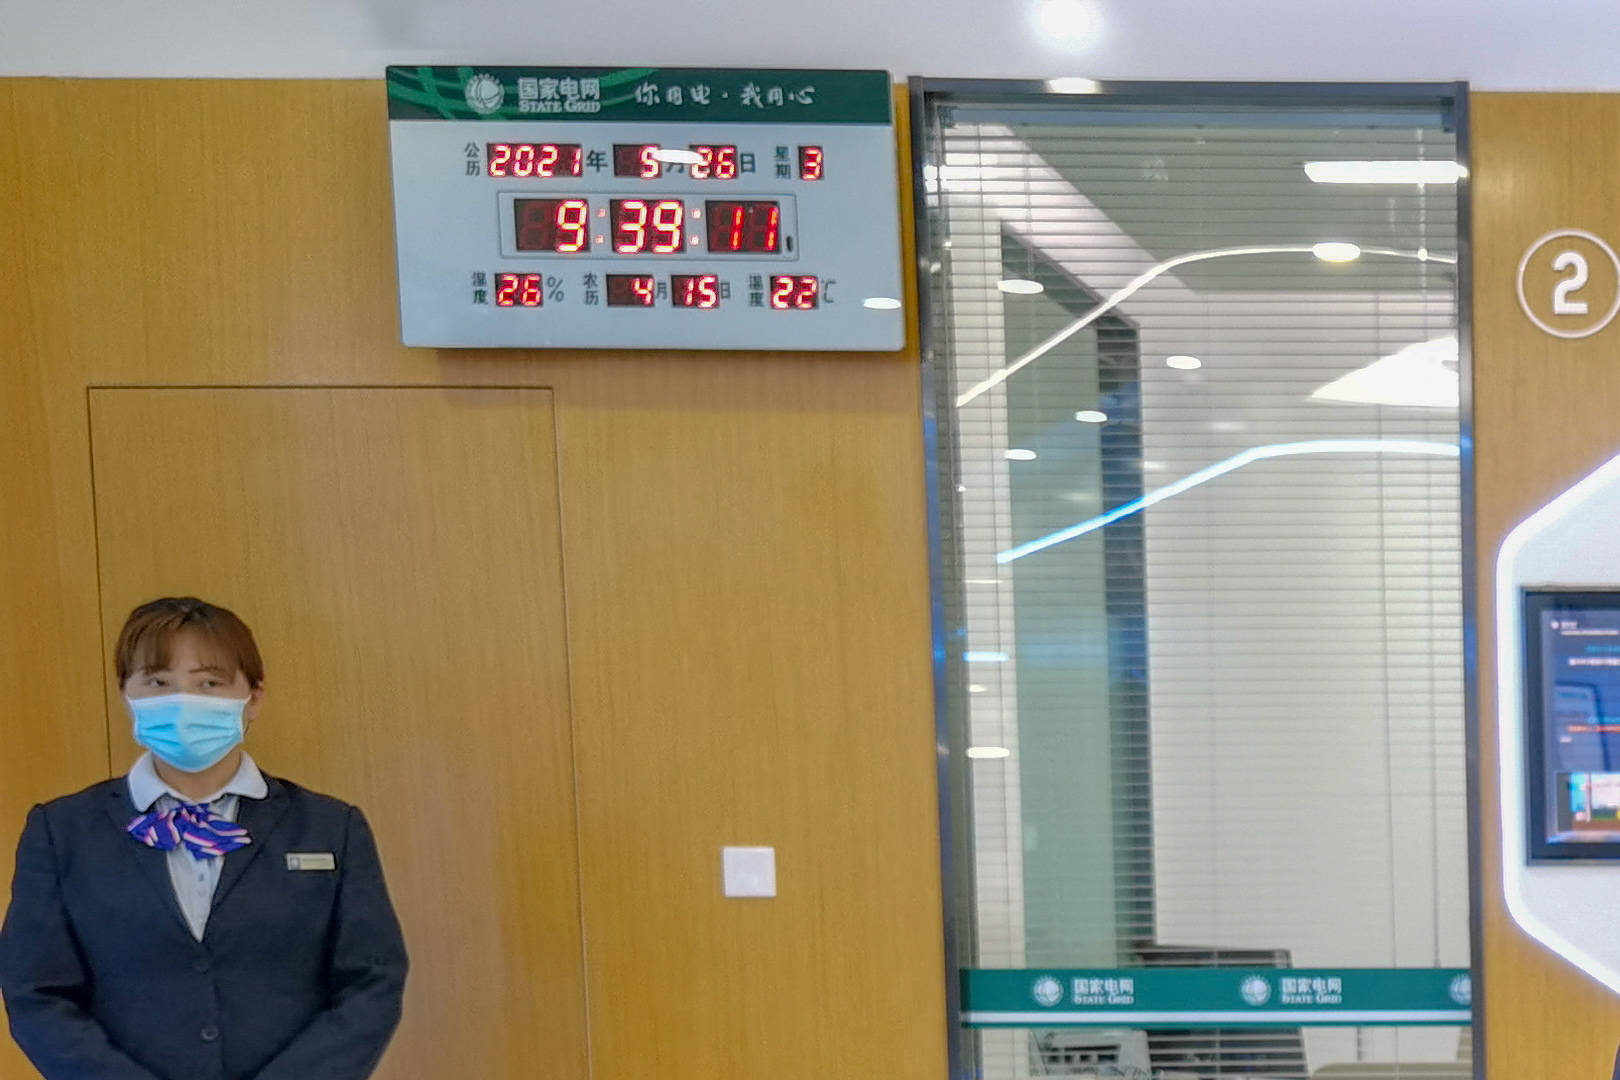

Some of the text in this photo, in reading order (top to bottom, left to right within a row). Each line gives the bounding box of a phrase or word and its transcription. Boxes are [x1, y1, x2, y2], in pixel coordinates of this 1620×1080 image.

[517, 76, 601, 100] 国家电网
[519, 101, 601, 113] STATE GRID
[489, 143, 583, 178] 2021
[1552, 251, 1588, 315] 2
[1074, 977, 1134, 994] 国家电网
[1282, 977, 1342, 994] 国家电网
